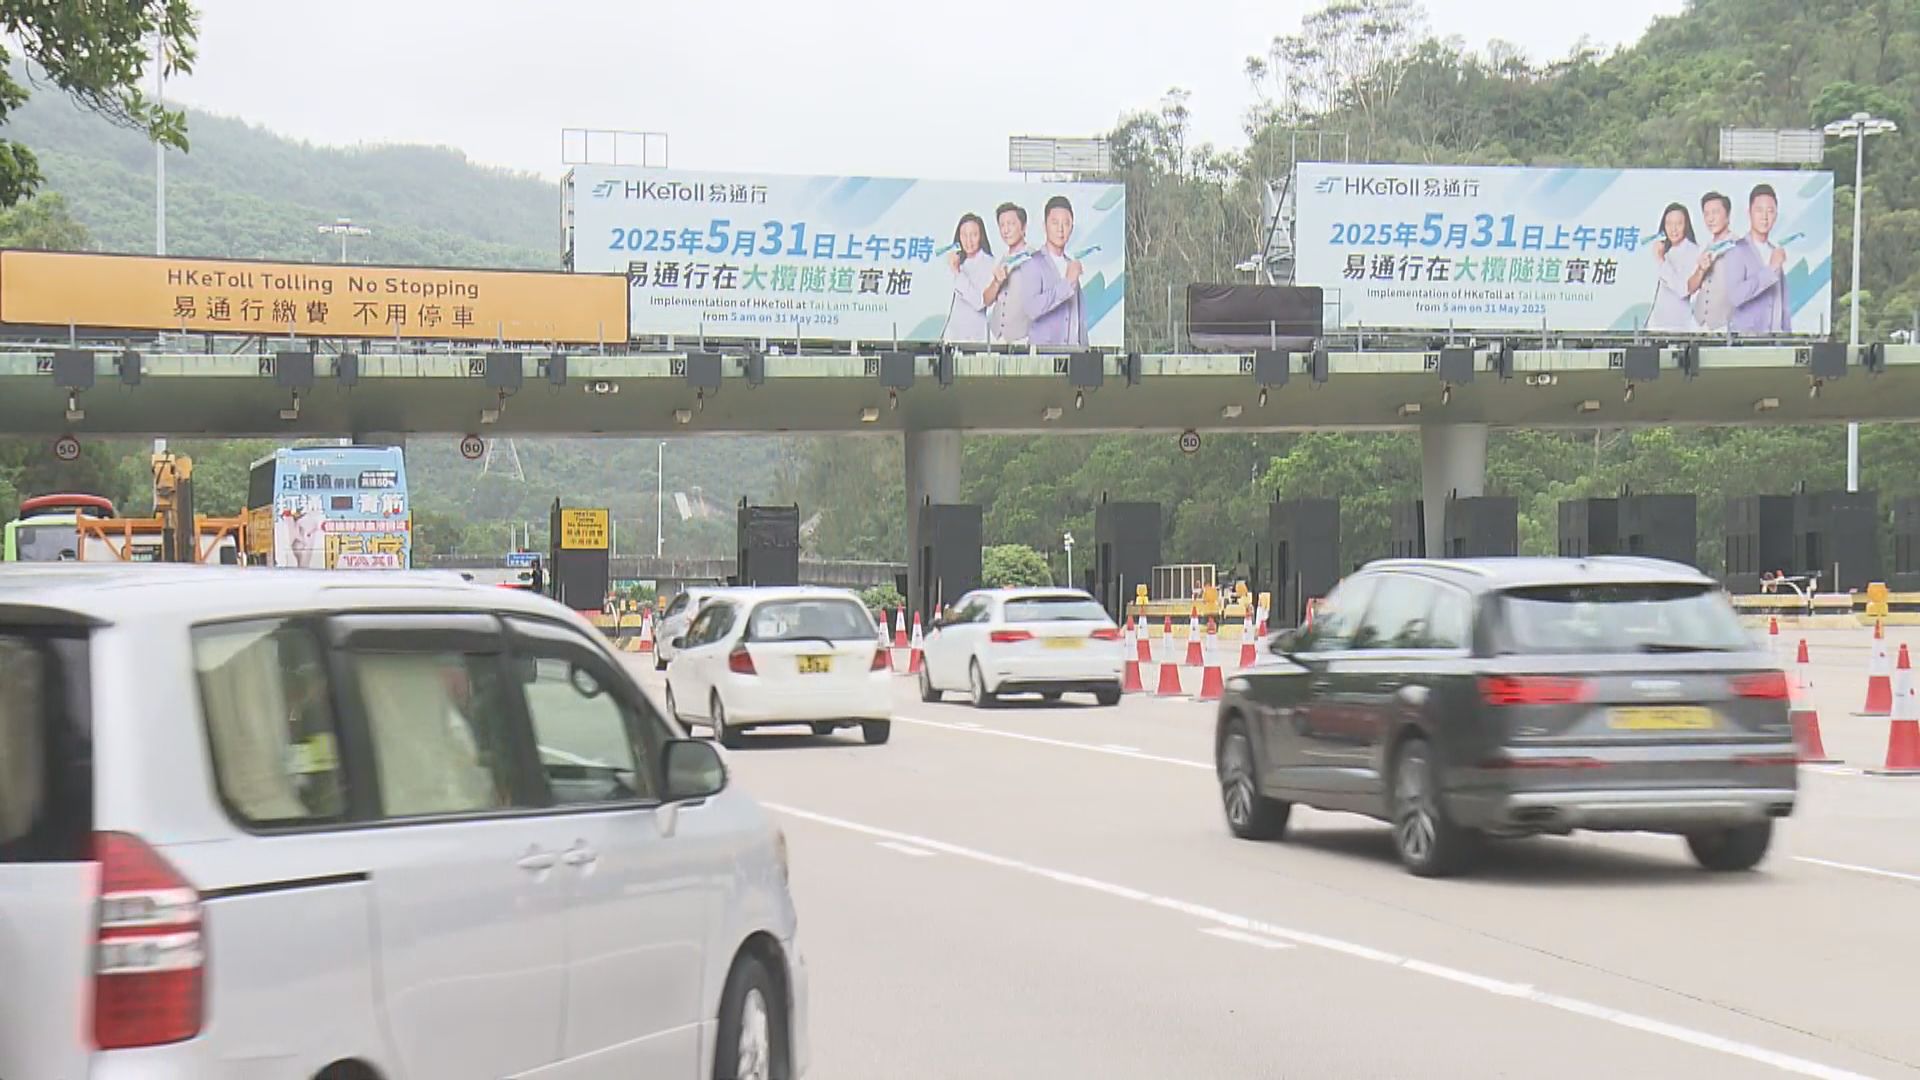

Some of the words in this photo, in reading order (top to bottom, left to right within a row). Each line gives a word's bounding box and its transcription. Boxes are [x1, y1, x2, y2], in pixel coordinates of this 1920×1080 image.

[624, 181, 704, 201] HKeToll
[1345, 176, 1420, 196] HKeToll
[1424, 178, 1479, 197] 易通行
[710, 184, 768, 203] 易通行
[1329, 212, 1640, 251] 2025年5月31日上午5時
[608, 220, 934, 263] 2025年5月31日上午5時
[167, 269, 254, 289] HKeToll
[261, 273, 333, 295] Tolling
[349, 276, 378, 293] No
[385, 278, 479, 299] Stopping
[1367, 288, 1449, 299] Implementation
[1451, 289, 1462, 299] of
[1505, 292, 1515, 300] at
[650, 295, 737, 307] Implementation
[739, 297, 750, 308] of
[753, 298, 793, 309] HKeToll
[796, 301, 806, 309] at
[1416, 302, 1440, 312] from
[1500, 304, 1518, 315] May
[1522, 305, 1546, 314] 2025
[173, 296, 329, 325] 易通行繳費
[353, 302, 476, 328] 不用停車
[702, 311, 728, 322] from
[739, 314, 756, 322] am
[758, 315, 772, 323] on
[775, 313, 787, 323] 31
[790, 314, 812, 326] May
[814, 315, 839, 324] 2025
[39, 357, 54, 371] 22
[470, 360, 484, 373] 20
[866, 360, 878, 373] 18
[1057, 360, 1068, 373] 17
[1241, 357, 1252, 371] 16
[1426, 354, 1438, 368] 15
[1611, 352, 1623, 367] 14
[262, 360, 275, 374] 21
[672, 361, 684, 374] 19
[464, 442, 480, 453] 50
[1183, 436, 1197, 447] 50
[60, 443, 76, 455] 50
